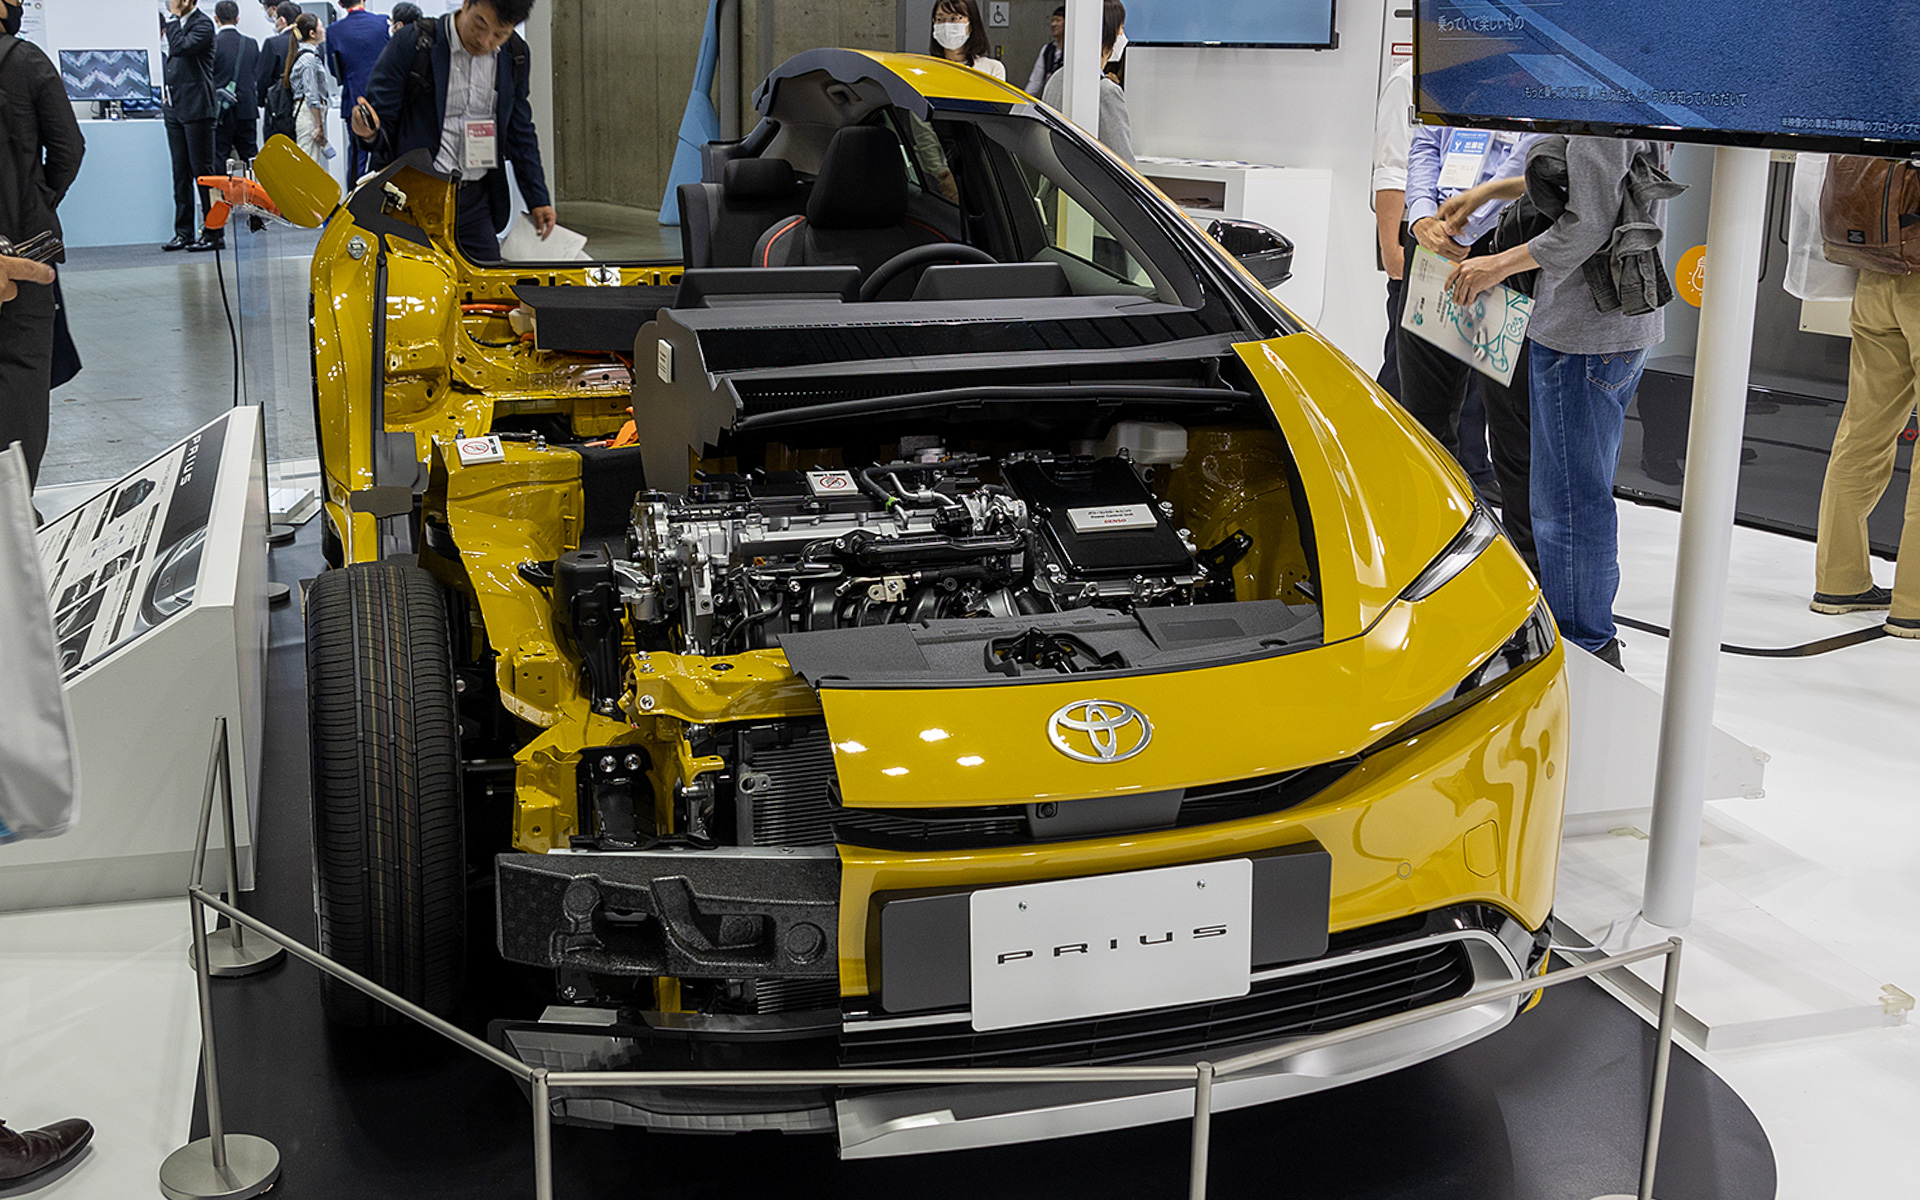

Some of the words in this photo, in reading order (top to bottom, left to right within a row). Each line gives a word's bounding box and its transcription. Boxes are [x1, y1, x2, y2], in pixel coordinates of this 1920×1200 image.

[1438, 14, 1525, 33] 乗っていて楽しいもの
[180, 434, 202, 486] PRIUS
[998, 924, 1227, 964] PRIUS
